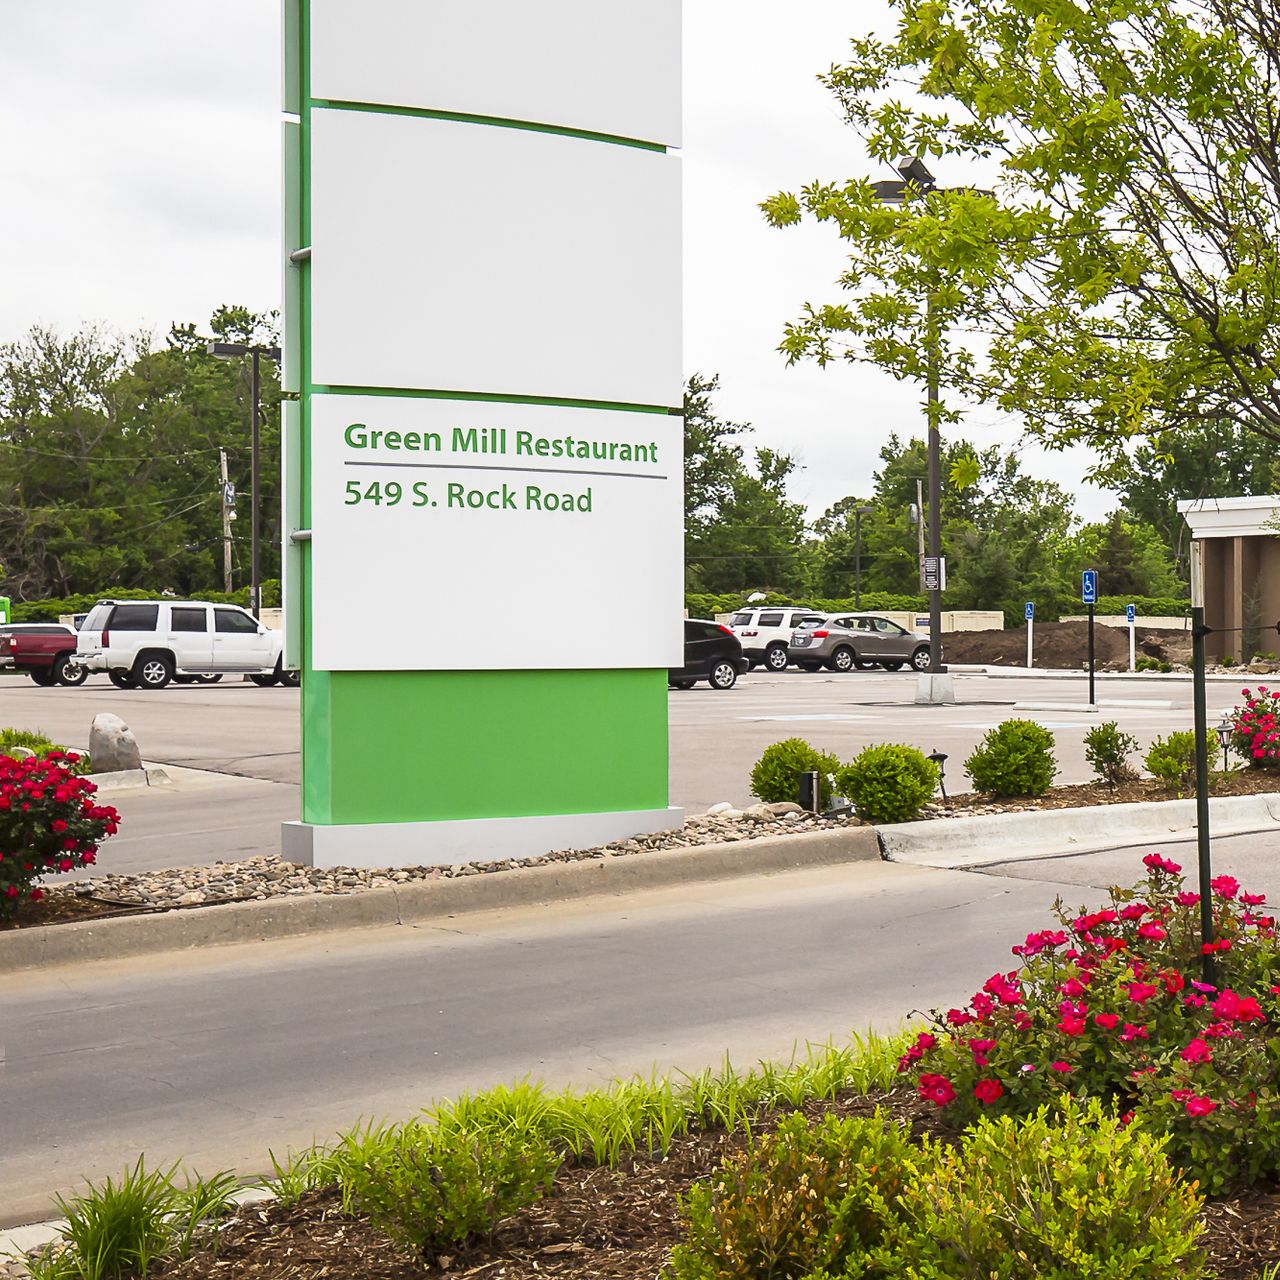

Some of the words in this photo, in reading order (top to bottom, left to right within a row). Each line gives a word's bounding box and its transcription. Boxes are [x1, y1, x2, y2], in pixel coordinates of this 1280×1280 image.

[344, 423, 442, 452] Green
[451, 427, 507, 455] Mill
[516, 430, 659, 464] Restaurant
[344, 480, 402, 506] 549
[411, 481, 438, 508] S.
[447, 483, 518, 510] Rock
[526, 485, 593, 513] Road
